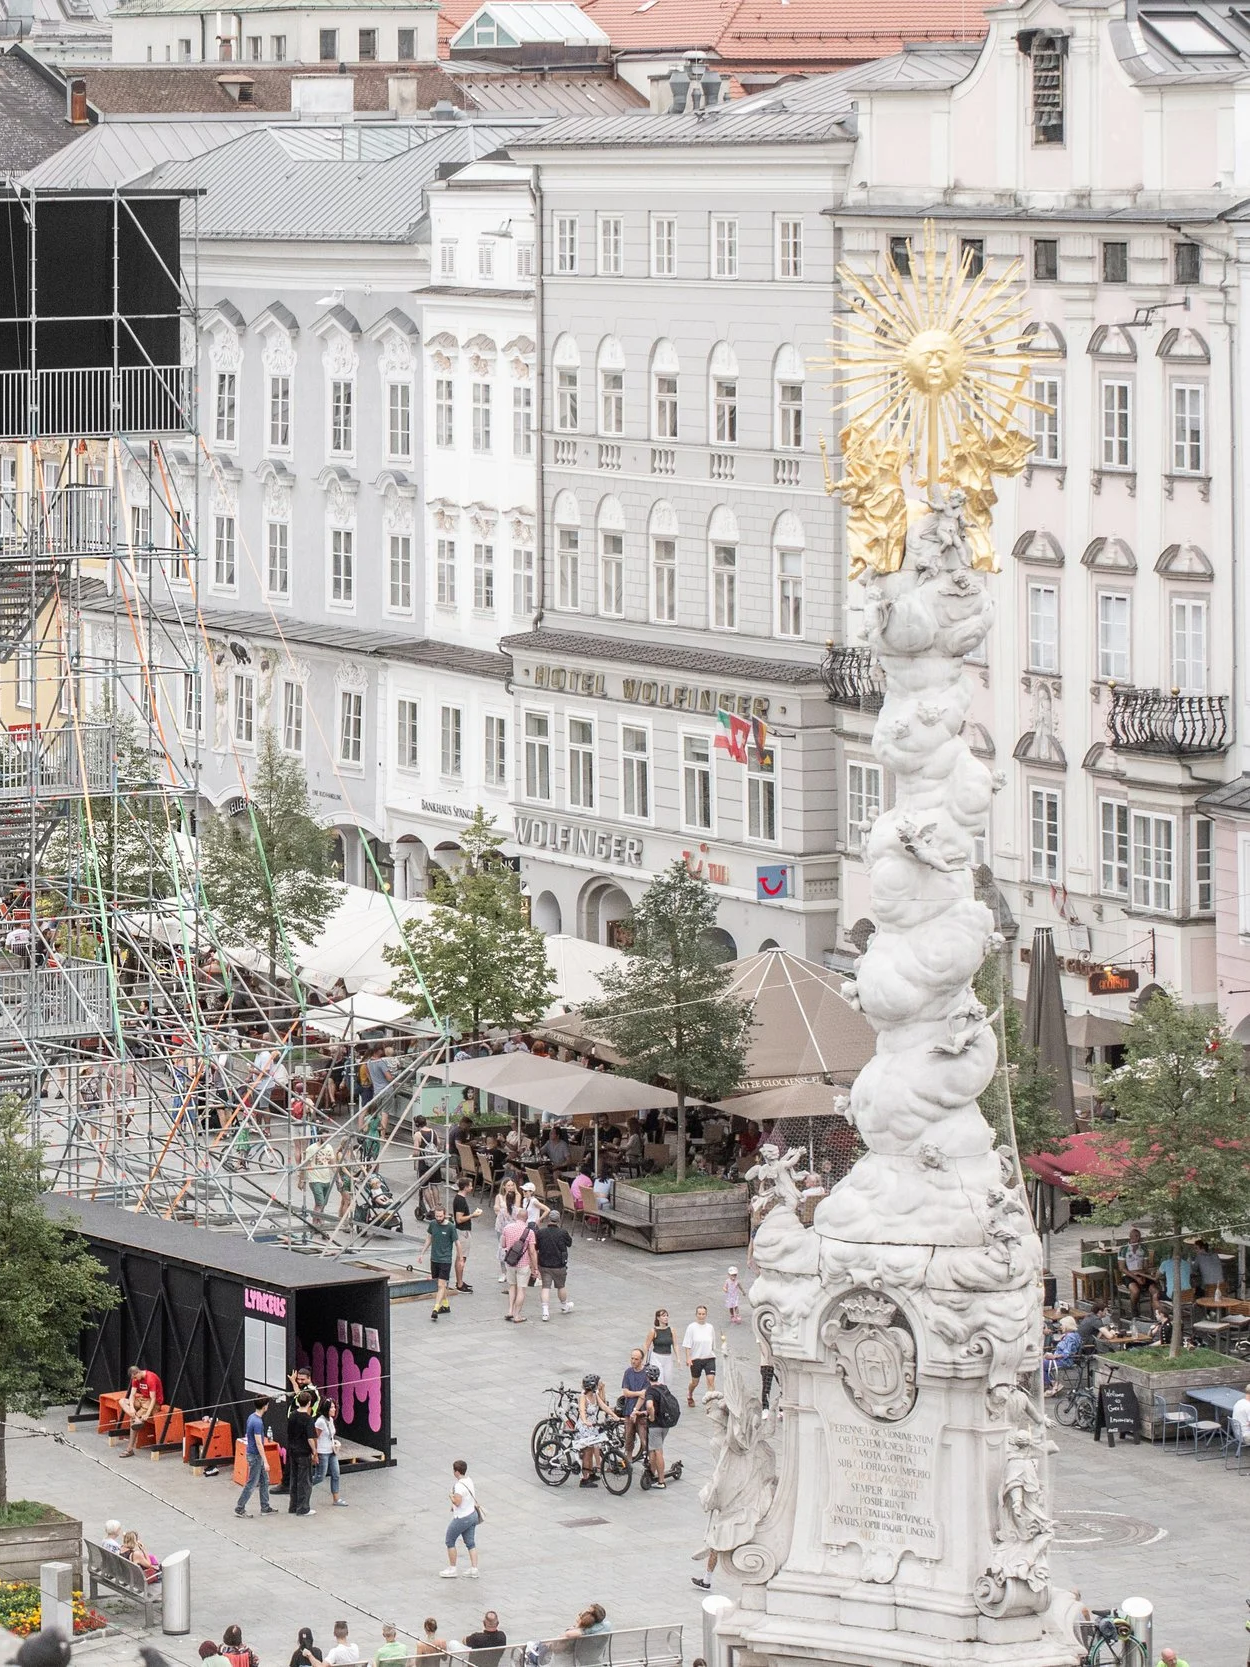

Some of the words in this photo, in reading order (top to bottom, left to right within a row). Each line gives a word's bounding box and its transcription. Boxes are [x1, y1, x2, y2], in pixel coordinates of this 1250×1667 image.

[534, 665, 608, 697] HOTEL
[622, 678, 770, 720] WOLFINGER
[421, 799, 452, 816] BANKHAUS
[512, 816, 644, 866] WOLFINGER
